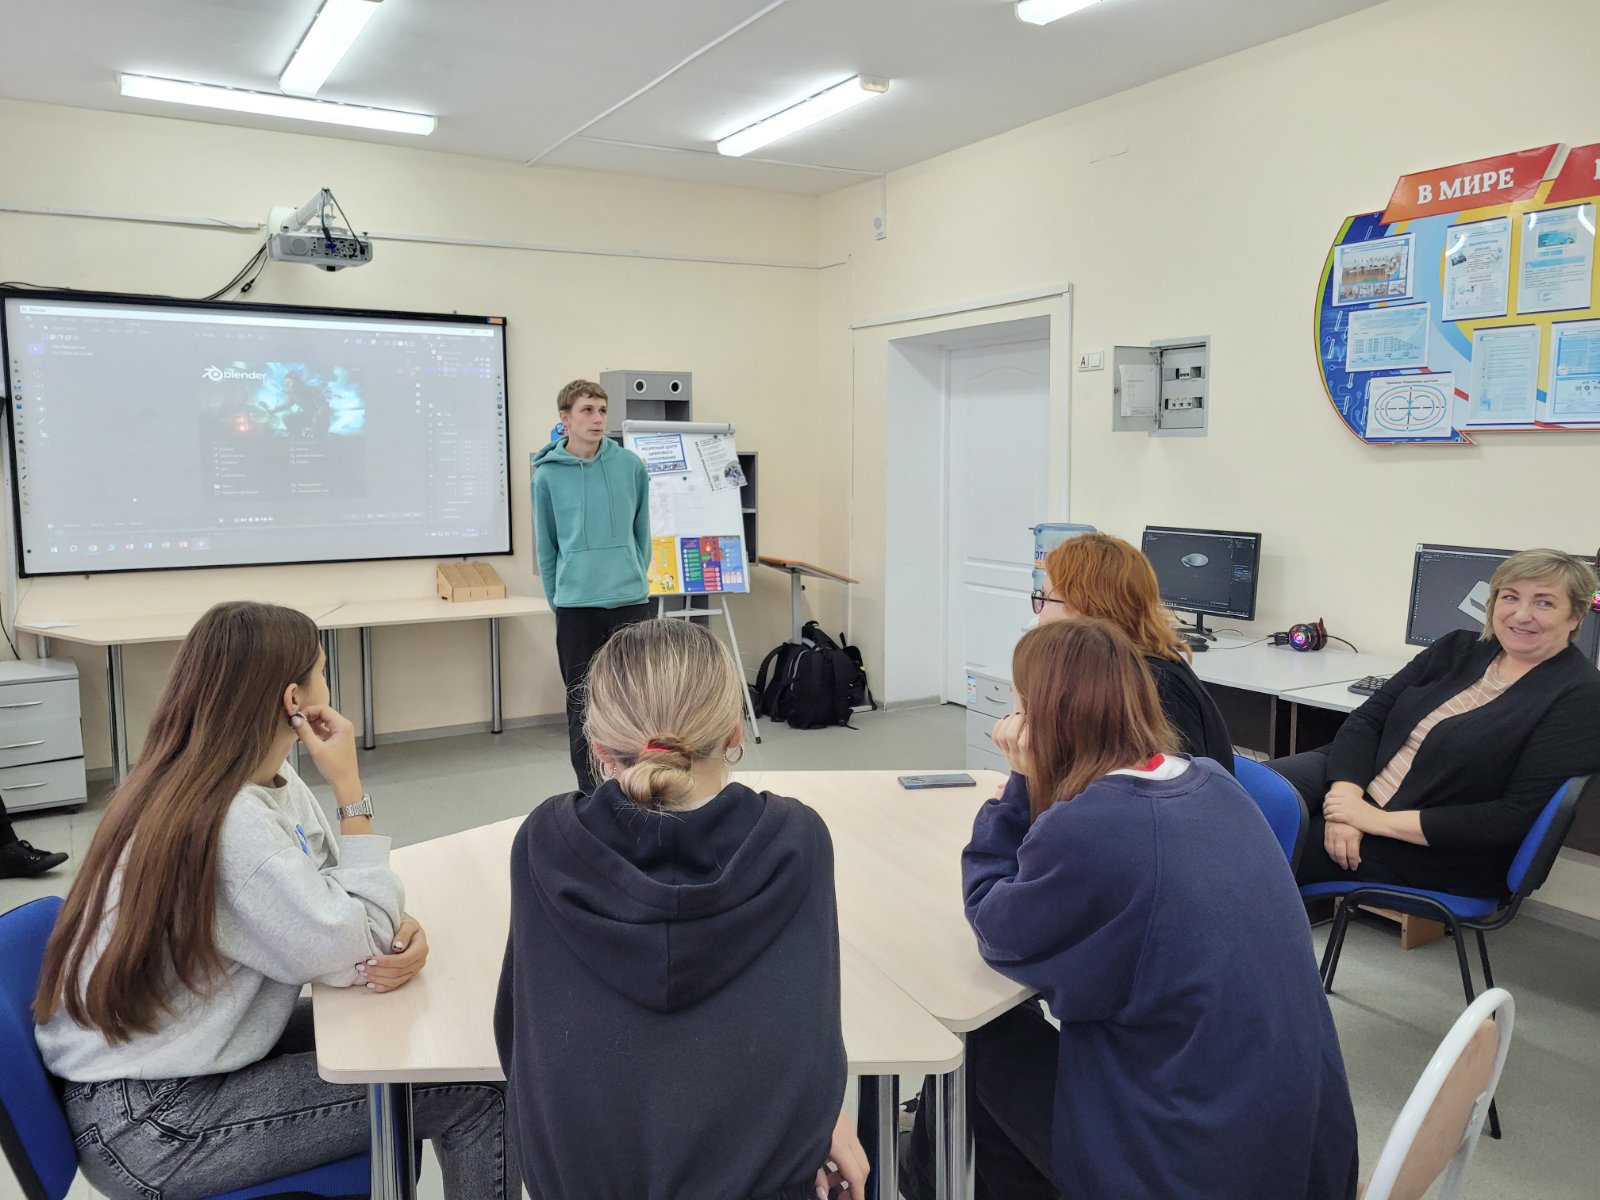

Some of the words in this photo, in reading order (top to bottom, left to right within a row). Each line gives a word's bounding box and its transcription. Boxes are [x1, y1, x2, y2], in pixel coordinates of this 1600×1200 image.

[1417, 184, 1433, 205] В
[1438, 167, 1514, 201] МИРЕ
[223, 370, 267, 380] blender
